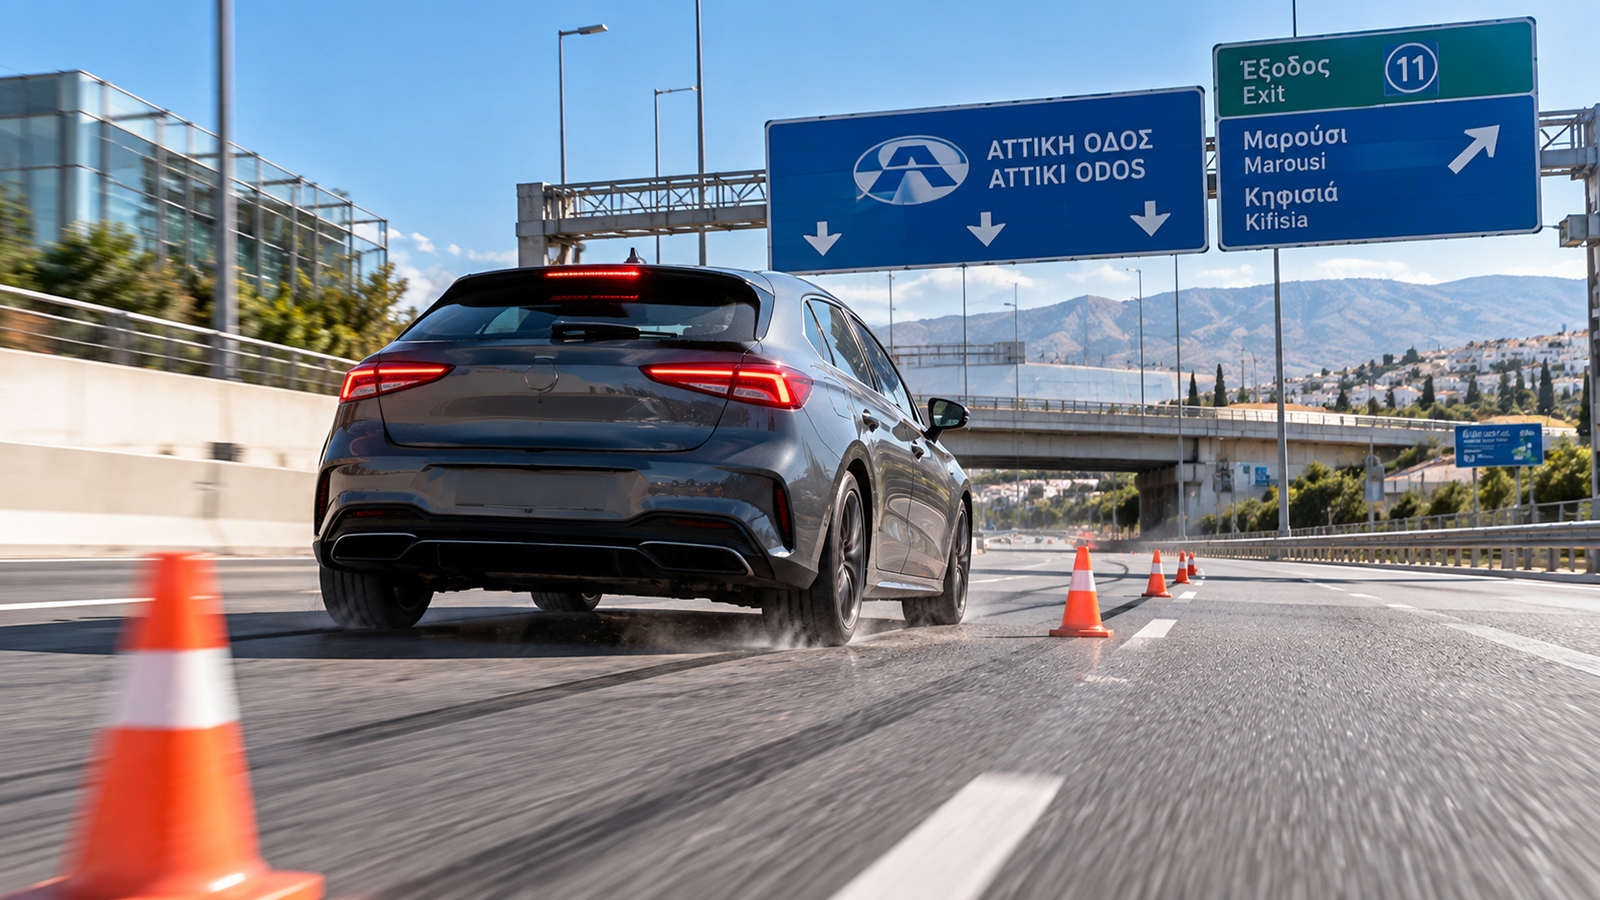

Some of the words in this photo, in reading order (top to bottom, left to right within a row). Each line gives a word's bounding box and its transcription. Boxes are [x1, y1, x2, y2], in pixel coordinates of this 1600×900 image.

[1240, 55, 1330, 83] Έξοδος
[1396, 54, 1425, 83] 11
[1243, 84, 1286, 105] Exit
[987, 134, 1075, 160] ΑΤΤΙΚΗ
[1084, 128, 1153, 153] ΟΔΟΣ
[1244, 124, 1348, 153] Μαρούσι
[988, 164, 1066, 189] ATTIKI
[1075, 158, 1146, 183] ODOS
[1244, 151, 1326, 175] Marousi
[1245, 180, 1339, 209] Κηφισιά
[1246, 211, 1308, 231] Kifisia
